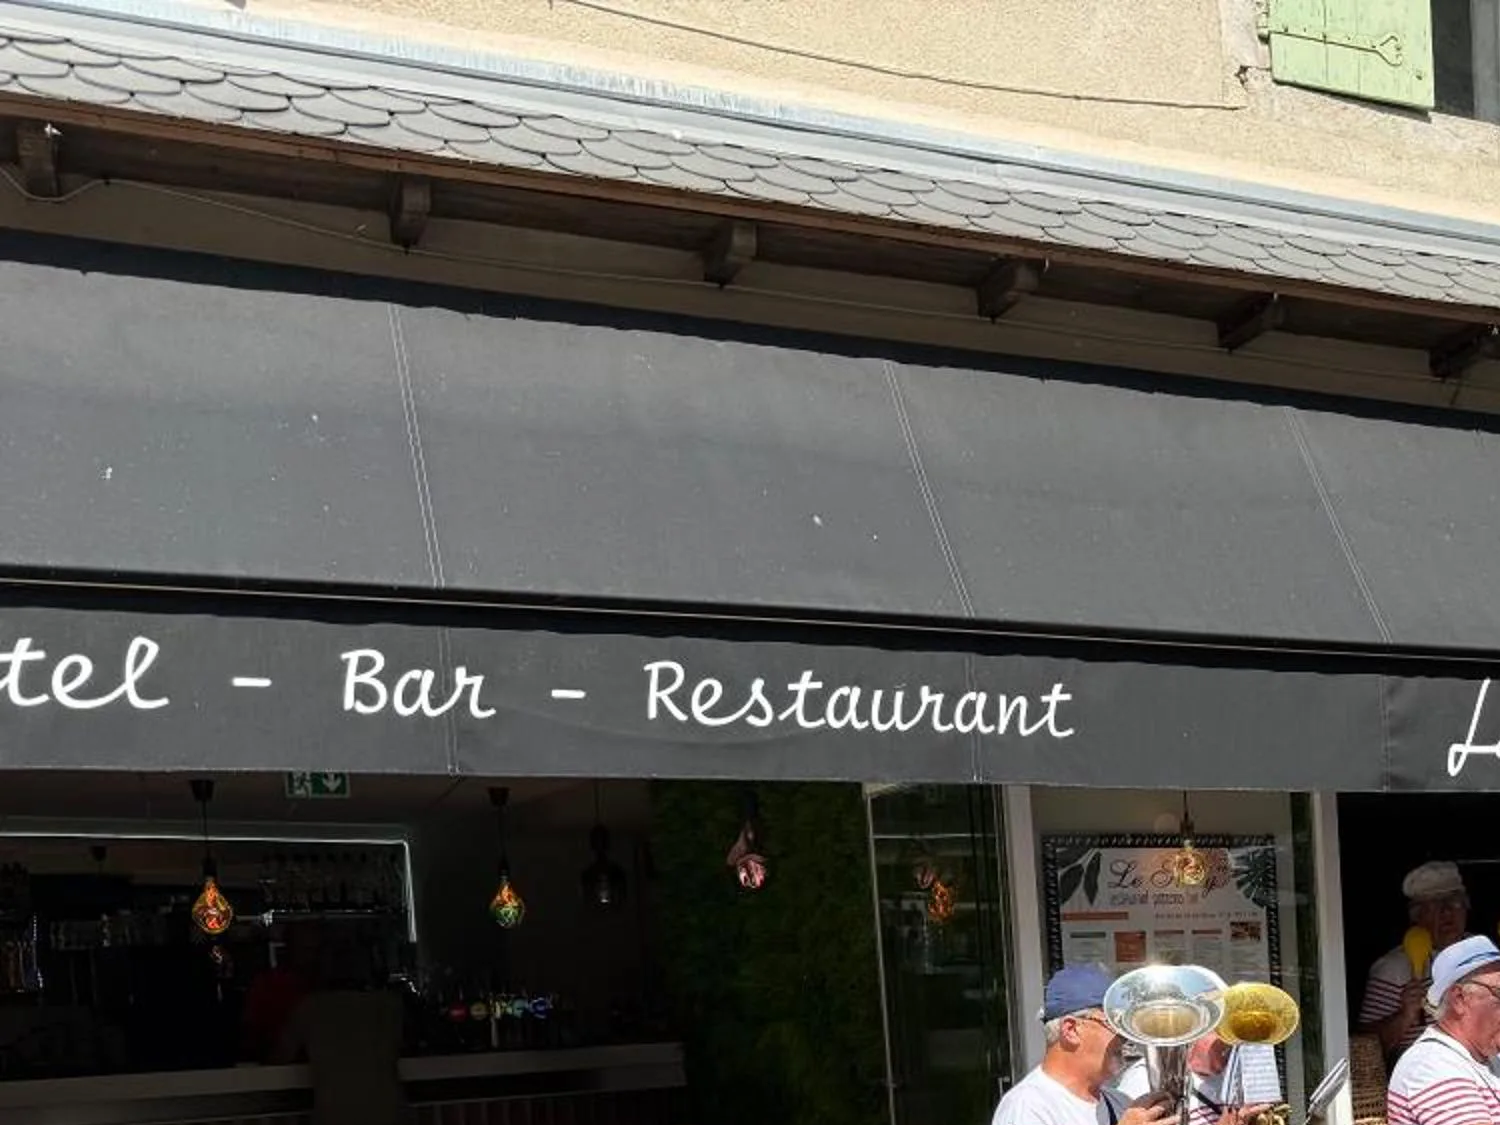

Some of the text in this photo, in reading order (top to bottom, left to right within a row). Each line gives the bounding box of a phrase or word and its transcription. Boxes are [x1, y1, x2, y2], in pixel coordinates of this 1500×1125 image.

[232, 677, 272, 687] -
[340, 648, 497, 719] Bar
[551, 689, 586, 699] -
[643, 660, 1075, 738] Restaurant
